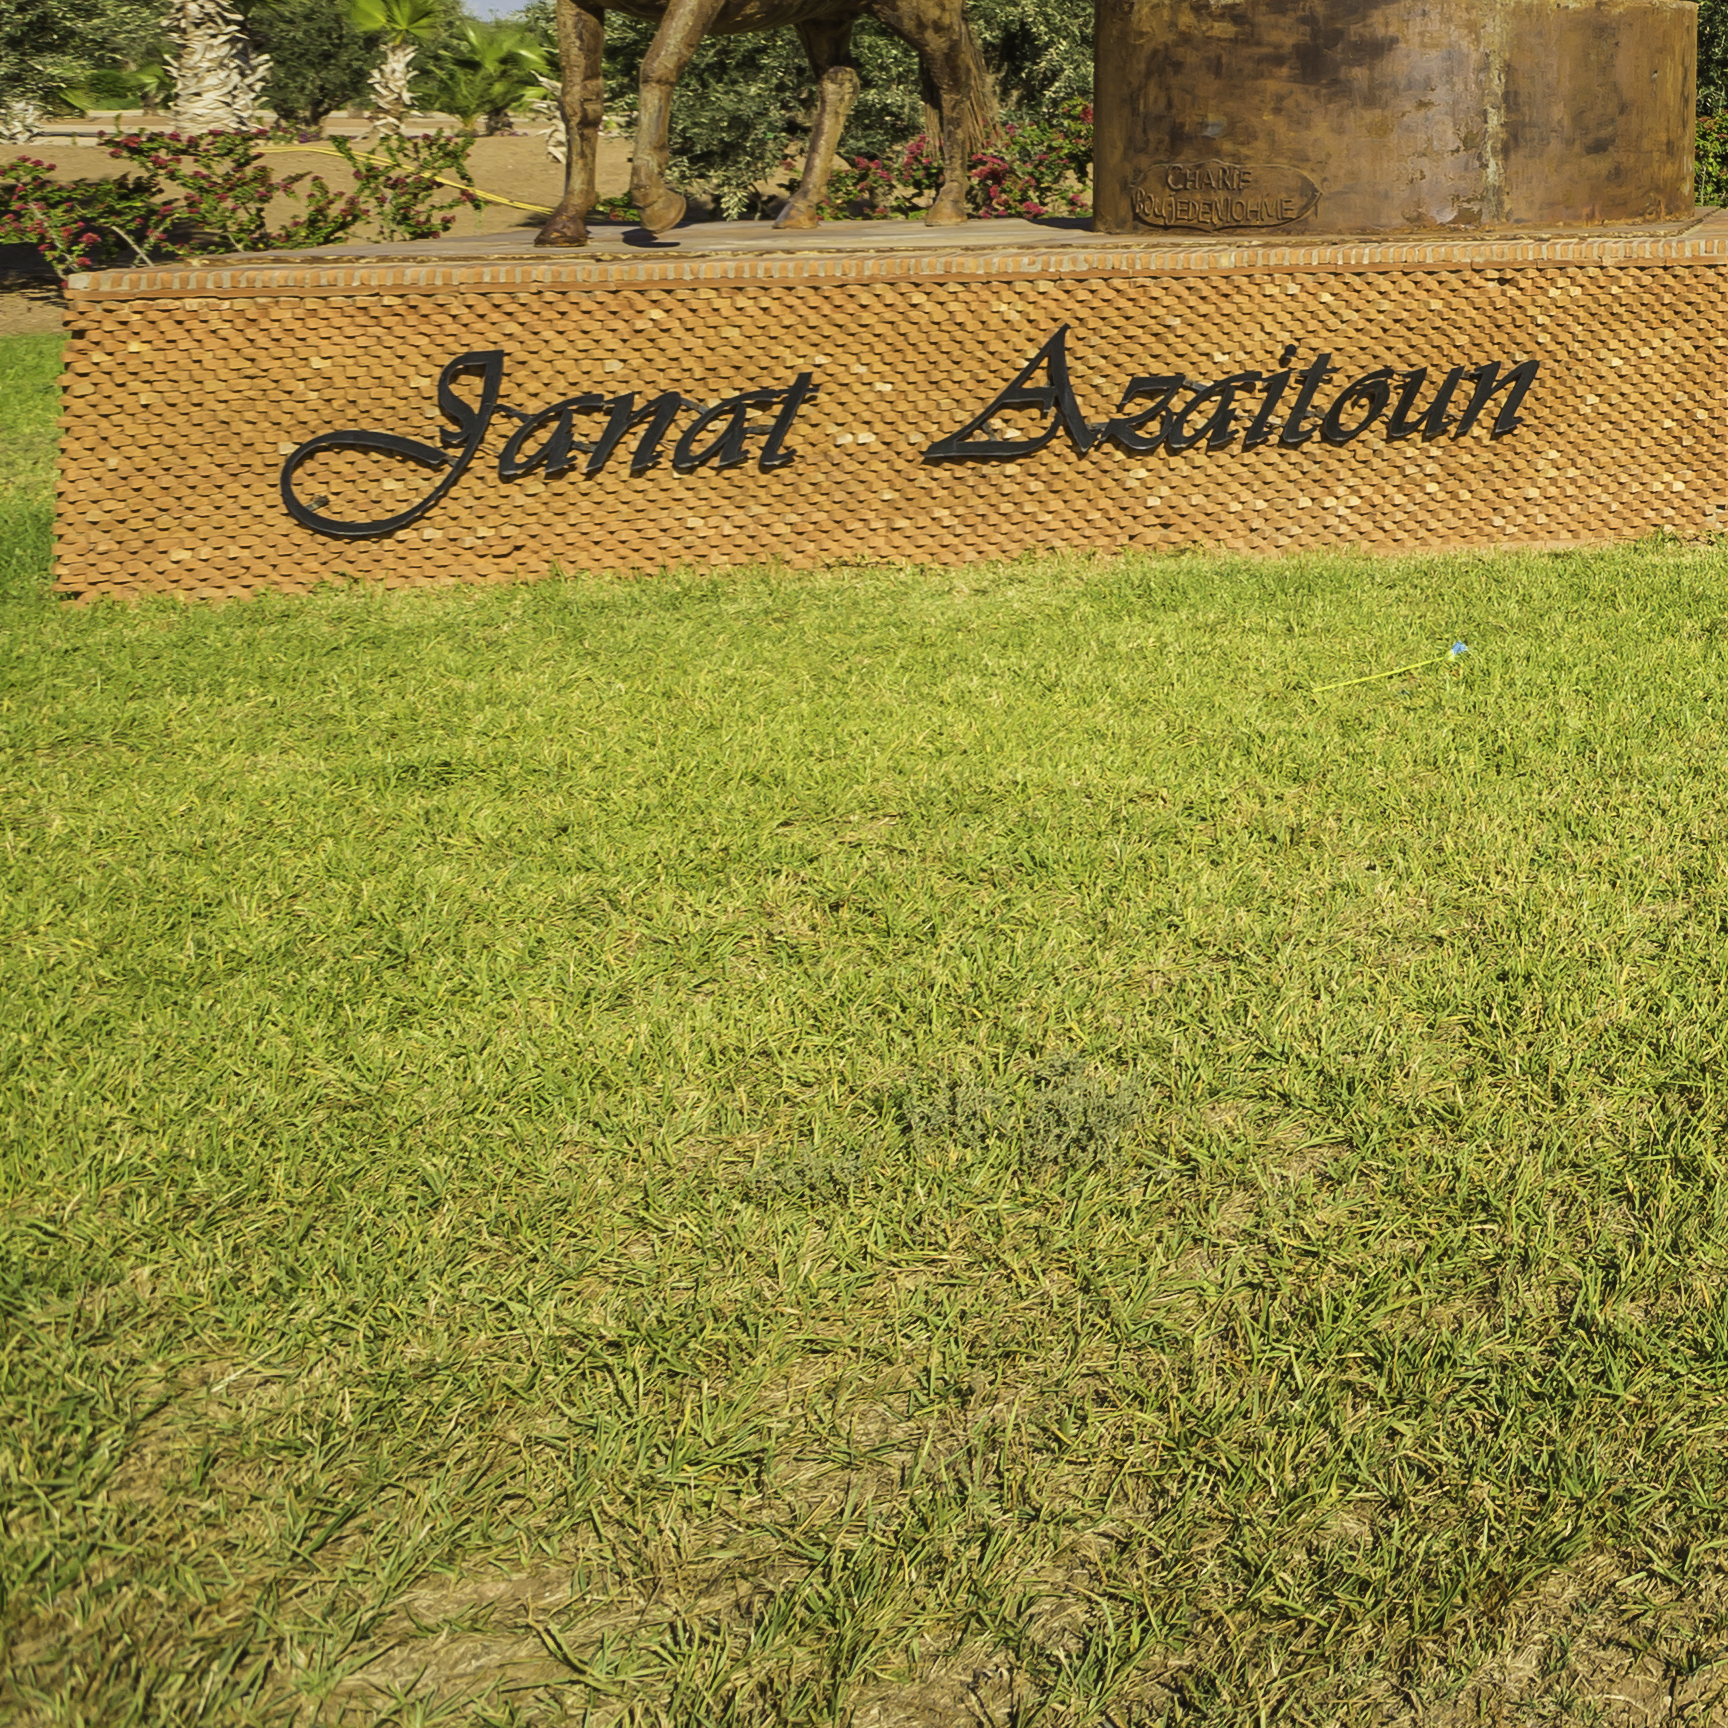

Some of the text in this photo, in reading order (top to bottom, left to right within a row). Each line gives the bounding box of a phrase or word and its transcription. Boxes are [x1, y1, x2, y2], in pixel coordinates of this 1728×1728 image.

[1166, 165, 1253, 191] CHARIF
[280, 322, 1540, 537] Janat Azaitoun
